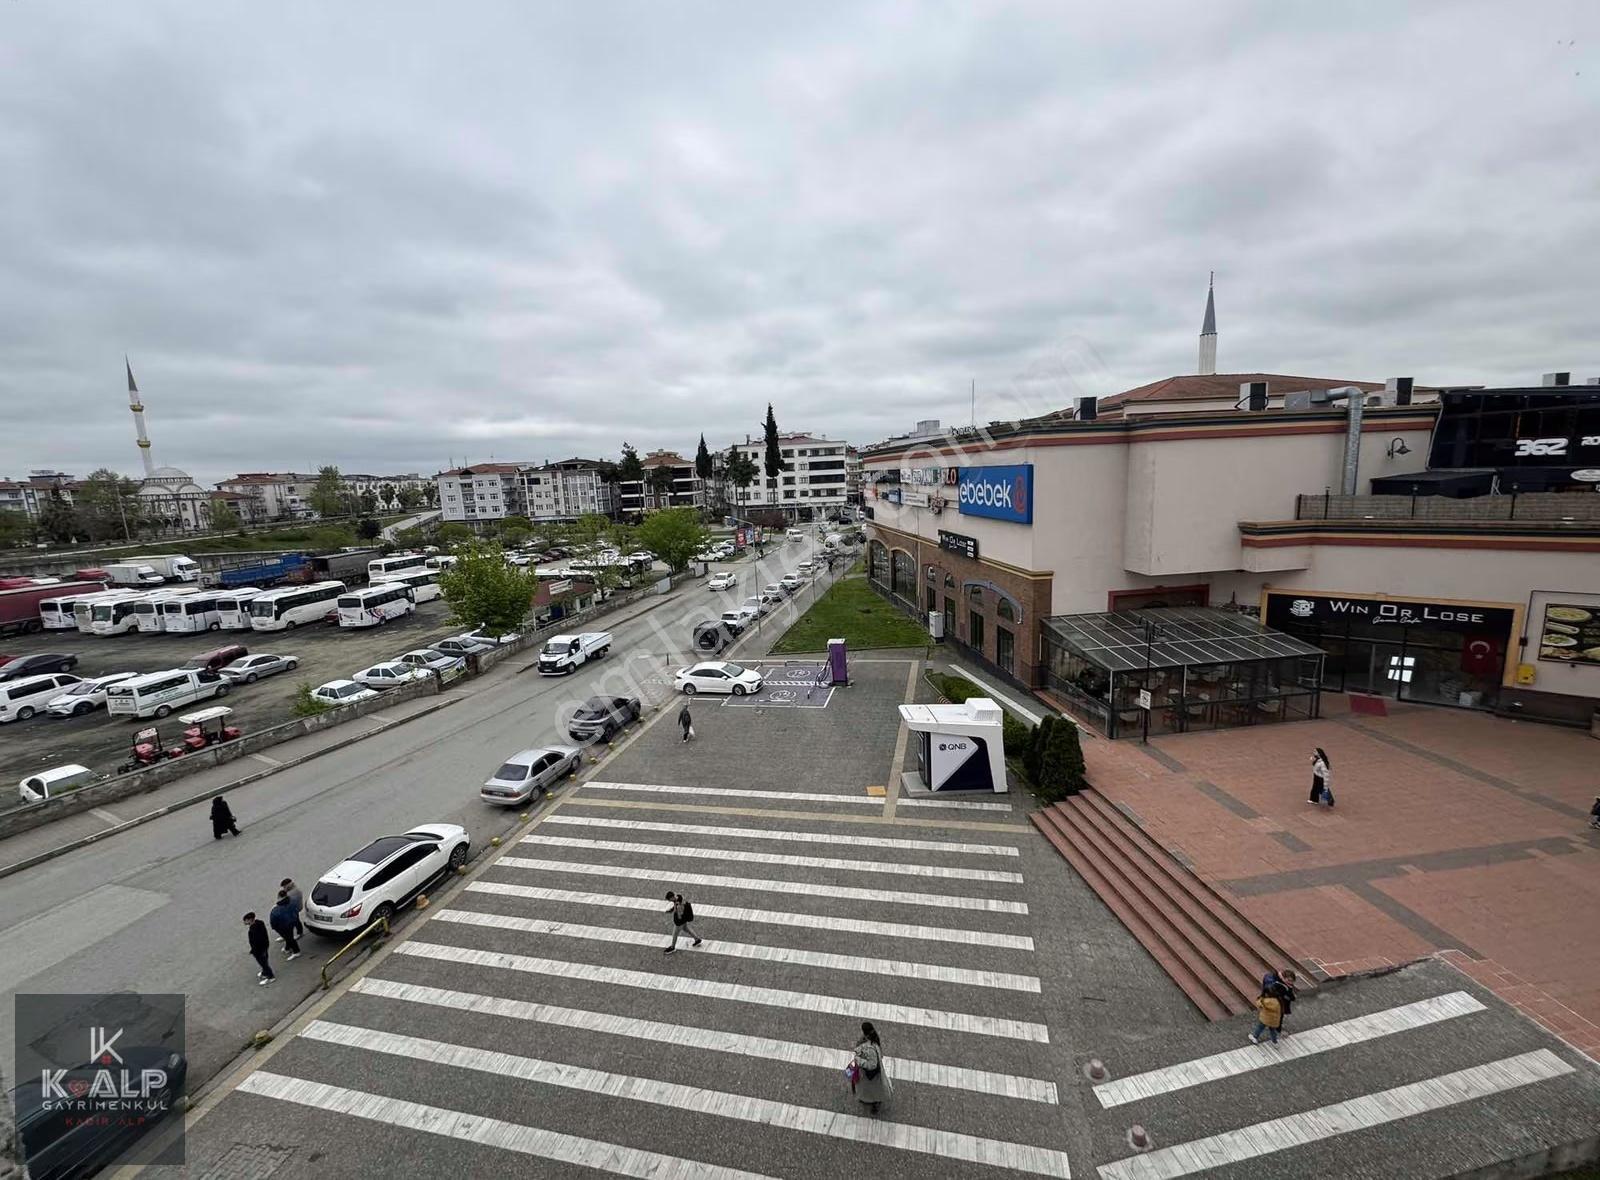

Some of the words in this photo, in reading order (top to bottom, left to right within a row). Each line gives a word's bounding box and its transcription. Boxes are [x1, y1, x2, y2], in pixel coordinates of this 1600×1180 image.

[1515, 437, 1569, 457] 362
[959, 478, 1012, 508] ebebek
[947, 743, 967, 751] QNB
